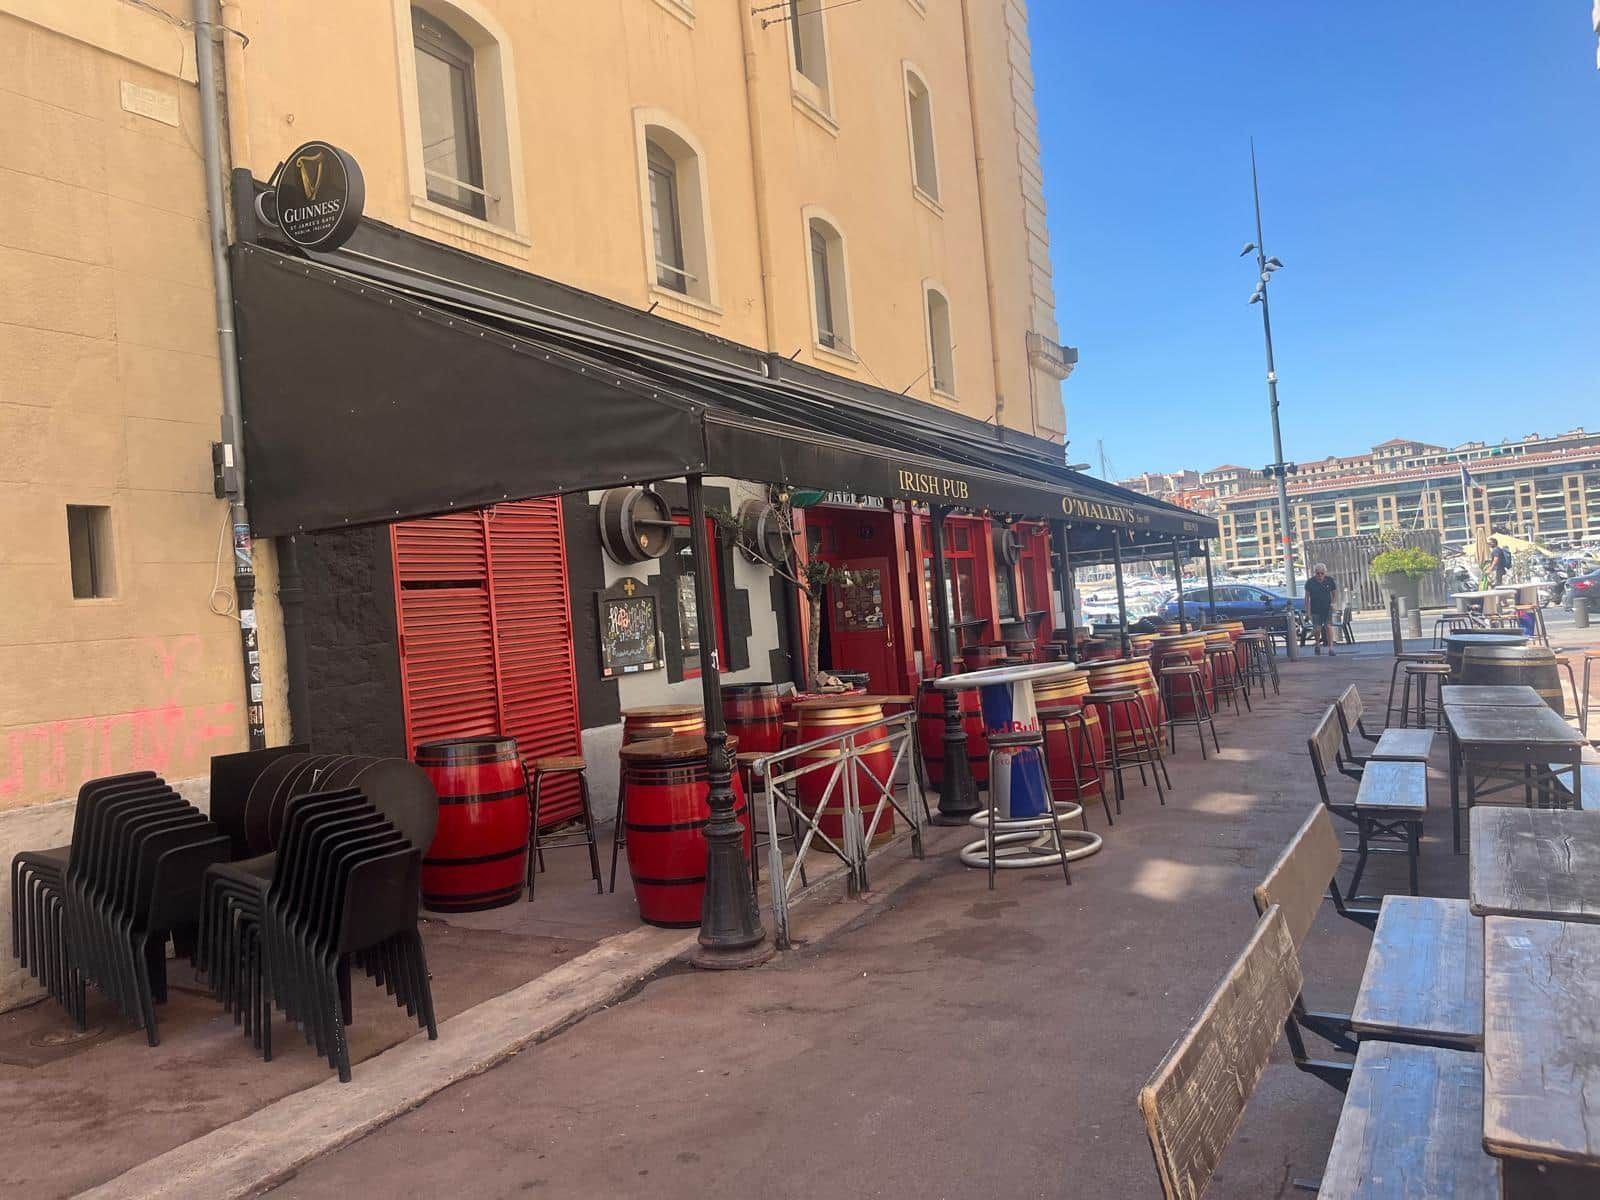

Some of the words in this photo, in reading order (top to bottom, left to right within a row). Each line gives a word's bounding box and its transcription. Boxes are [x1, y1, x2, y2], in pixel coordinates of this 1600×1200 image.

[284, 199, 340, 224] GUINNESS
[899, 470, 940, 496] IRISH
[942, 478, 969, 499] PUB
[1062, 496, 1136, 523] O'MALLEY'S
